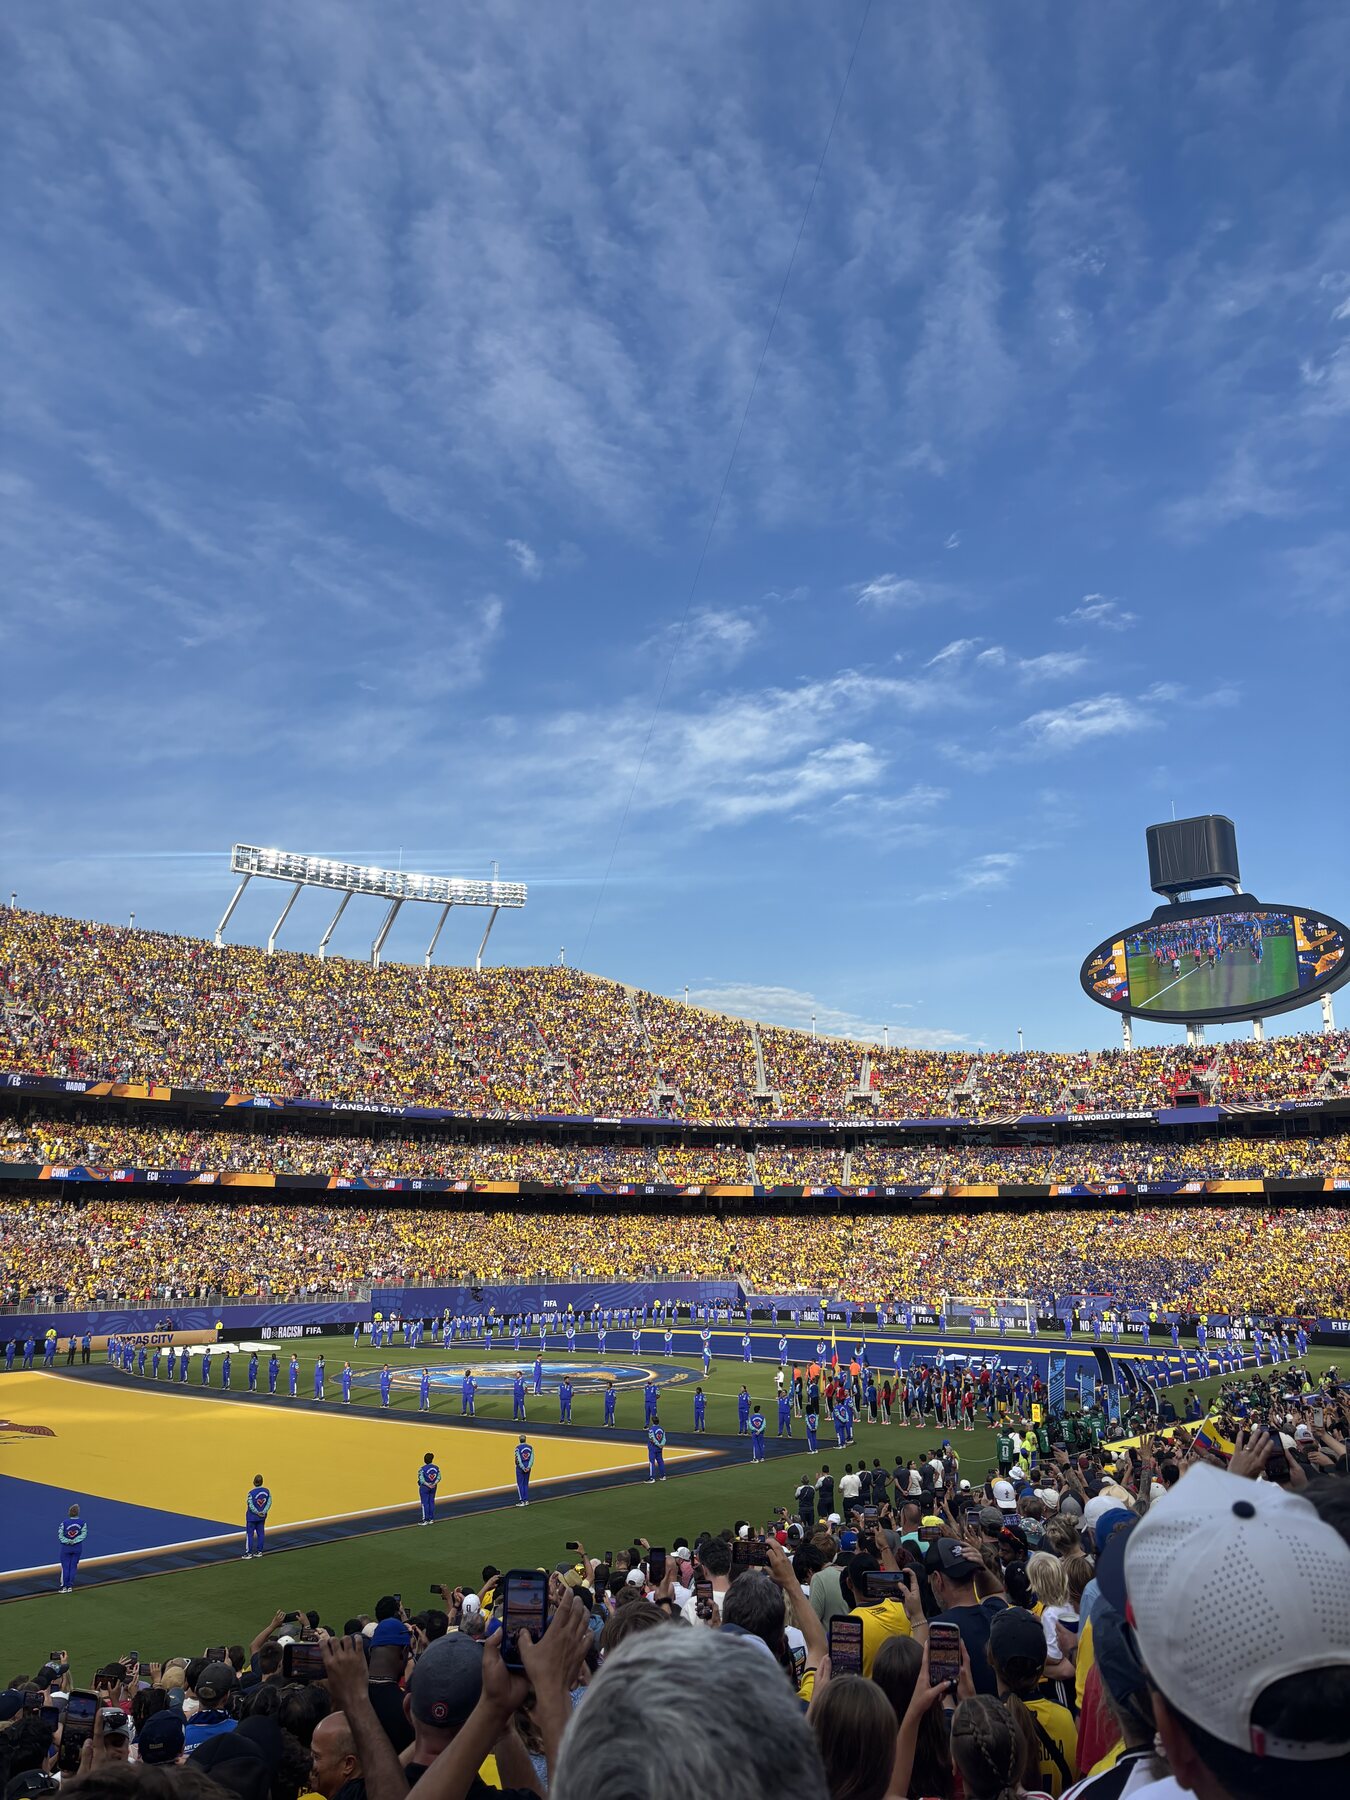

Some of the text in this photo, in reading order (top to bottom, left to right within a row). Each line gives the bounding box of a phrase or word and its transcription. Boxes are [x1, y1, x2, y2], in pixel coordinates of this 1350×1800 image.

[332, 1103, 405, 1115] KANSAS CITY
[1067, 1111, 1153, 1122] FIFA WORLD CUP 2026
[828, 1120, 875, 1128] KANSAS
[51, 1167, 69, 1178] CURA
[732, 1310, 744, 1318] FIFA
[918, 1316, 934, 1324] FIFA
[1079, 1320, 1089, 1332] NO
[261, 1325, 322, 1339] NO RACISM FIFA
[151, 1333, 174, 1345] CITY
